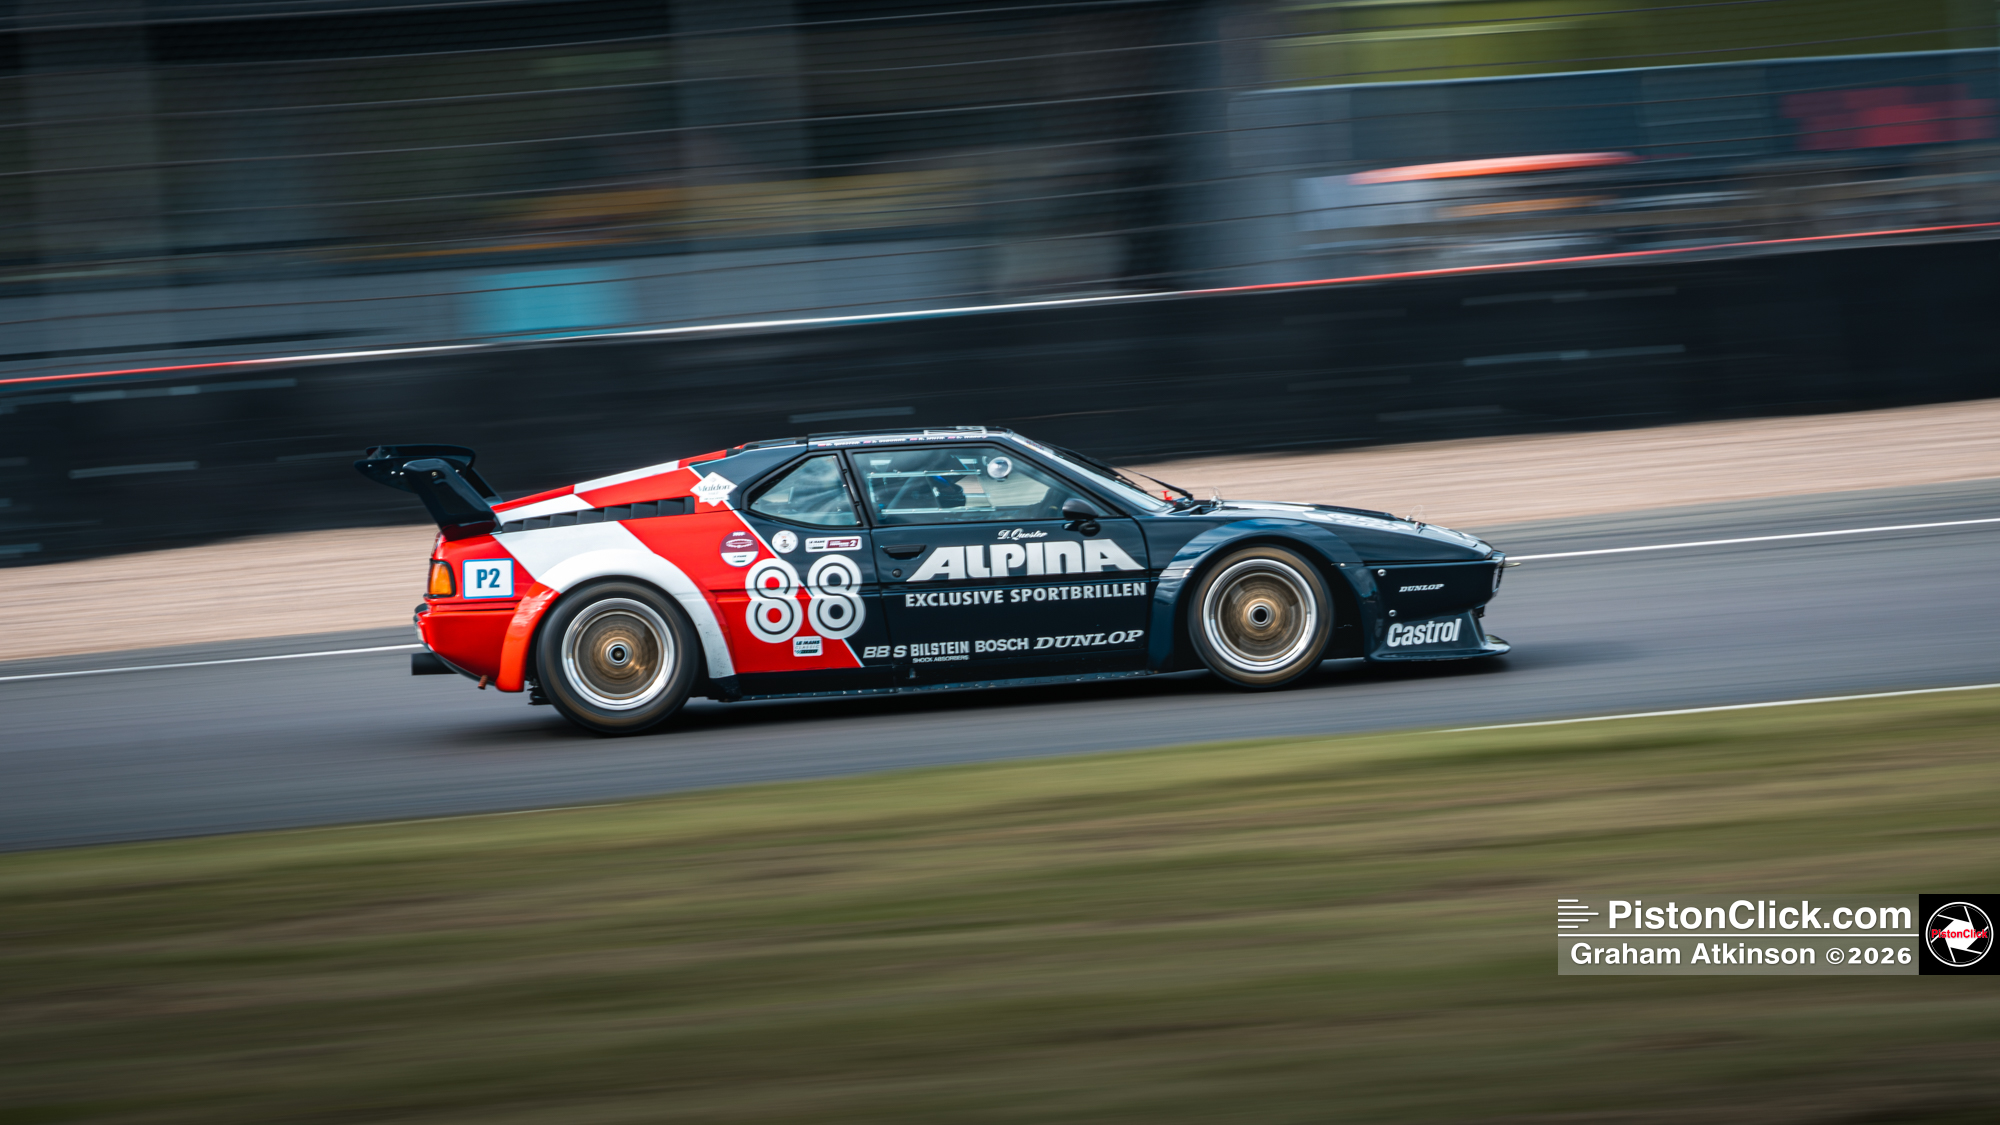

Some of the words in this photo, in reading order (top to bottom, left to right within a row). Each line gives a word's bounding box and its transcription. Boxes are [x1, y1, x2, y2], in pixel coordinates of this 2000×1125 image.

[906, 539, 1146, 582] ALPINA
[476, 568, 501, 589] P2
[1399, 584, 1445, 593] DUNLOP
[745, 554, 866, 643] 88
[905, 590, 1004, 608] EXCLUSIVE
[1010, 582, 1147, 603] SPORTBRILLEN
[1033, 629, 1144, 650] DUNLOP
[1386, 618, 1462, 647] Castrol
[910, 641, 970, 657] BILSTEIN
[975, 637, 1030, 653] BOSCH
[933, 655, 970, 663] ABSORBERS
